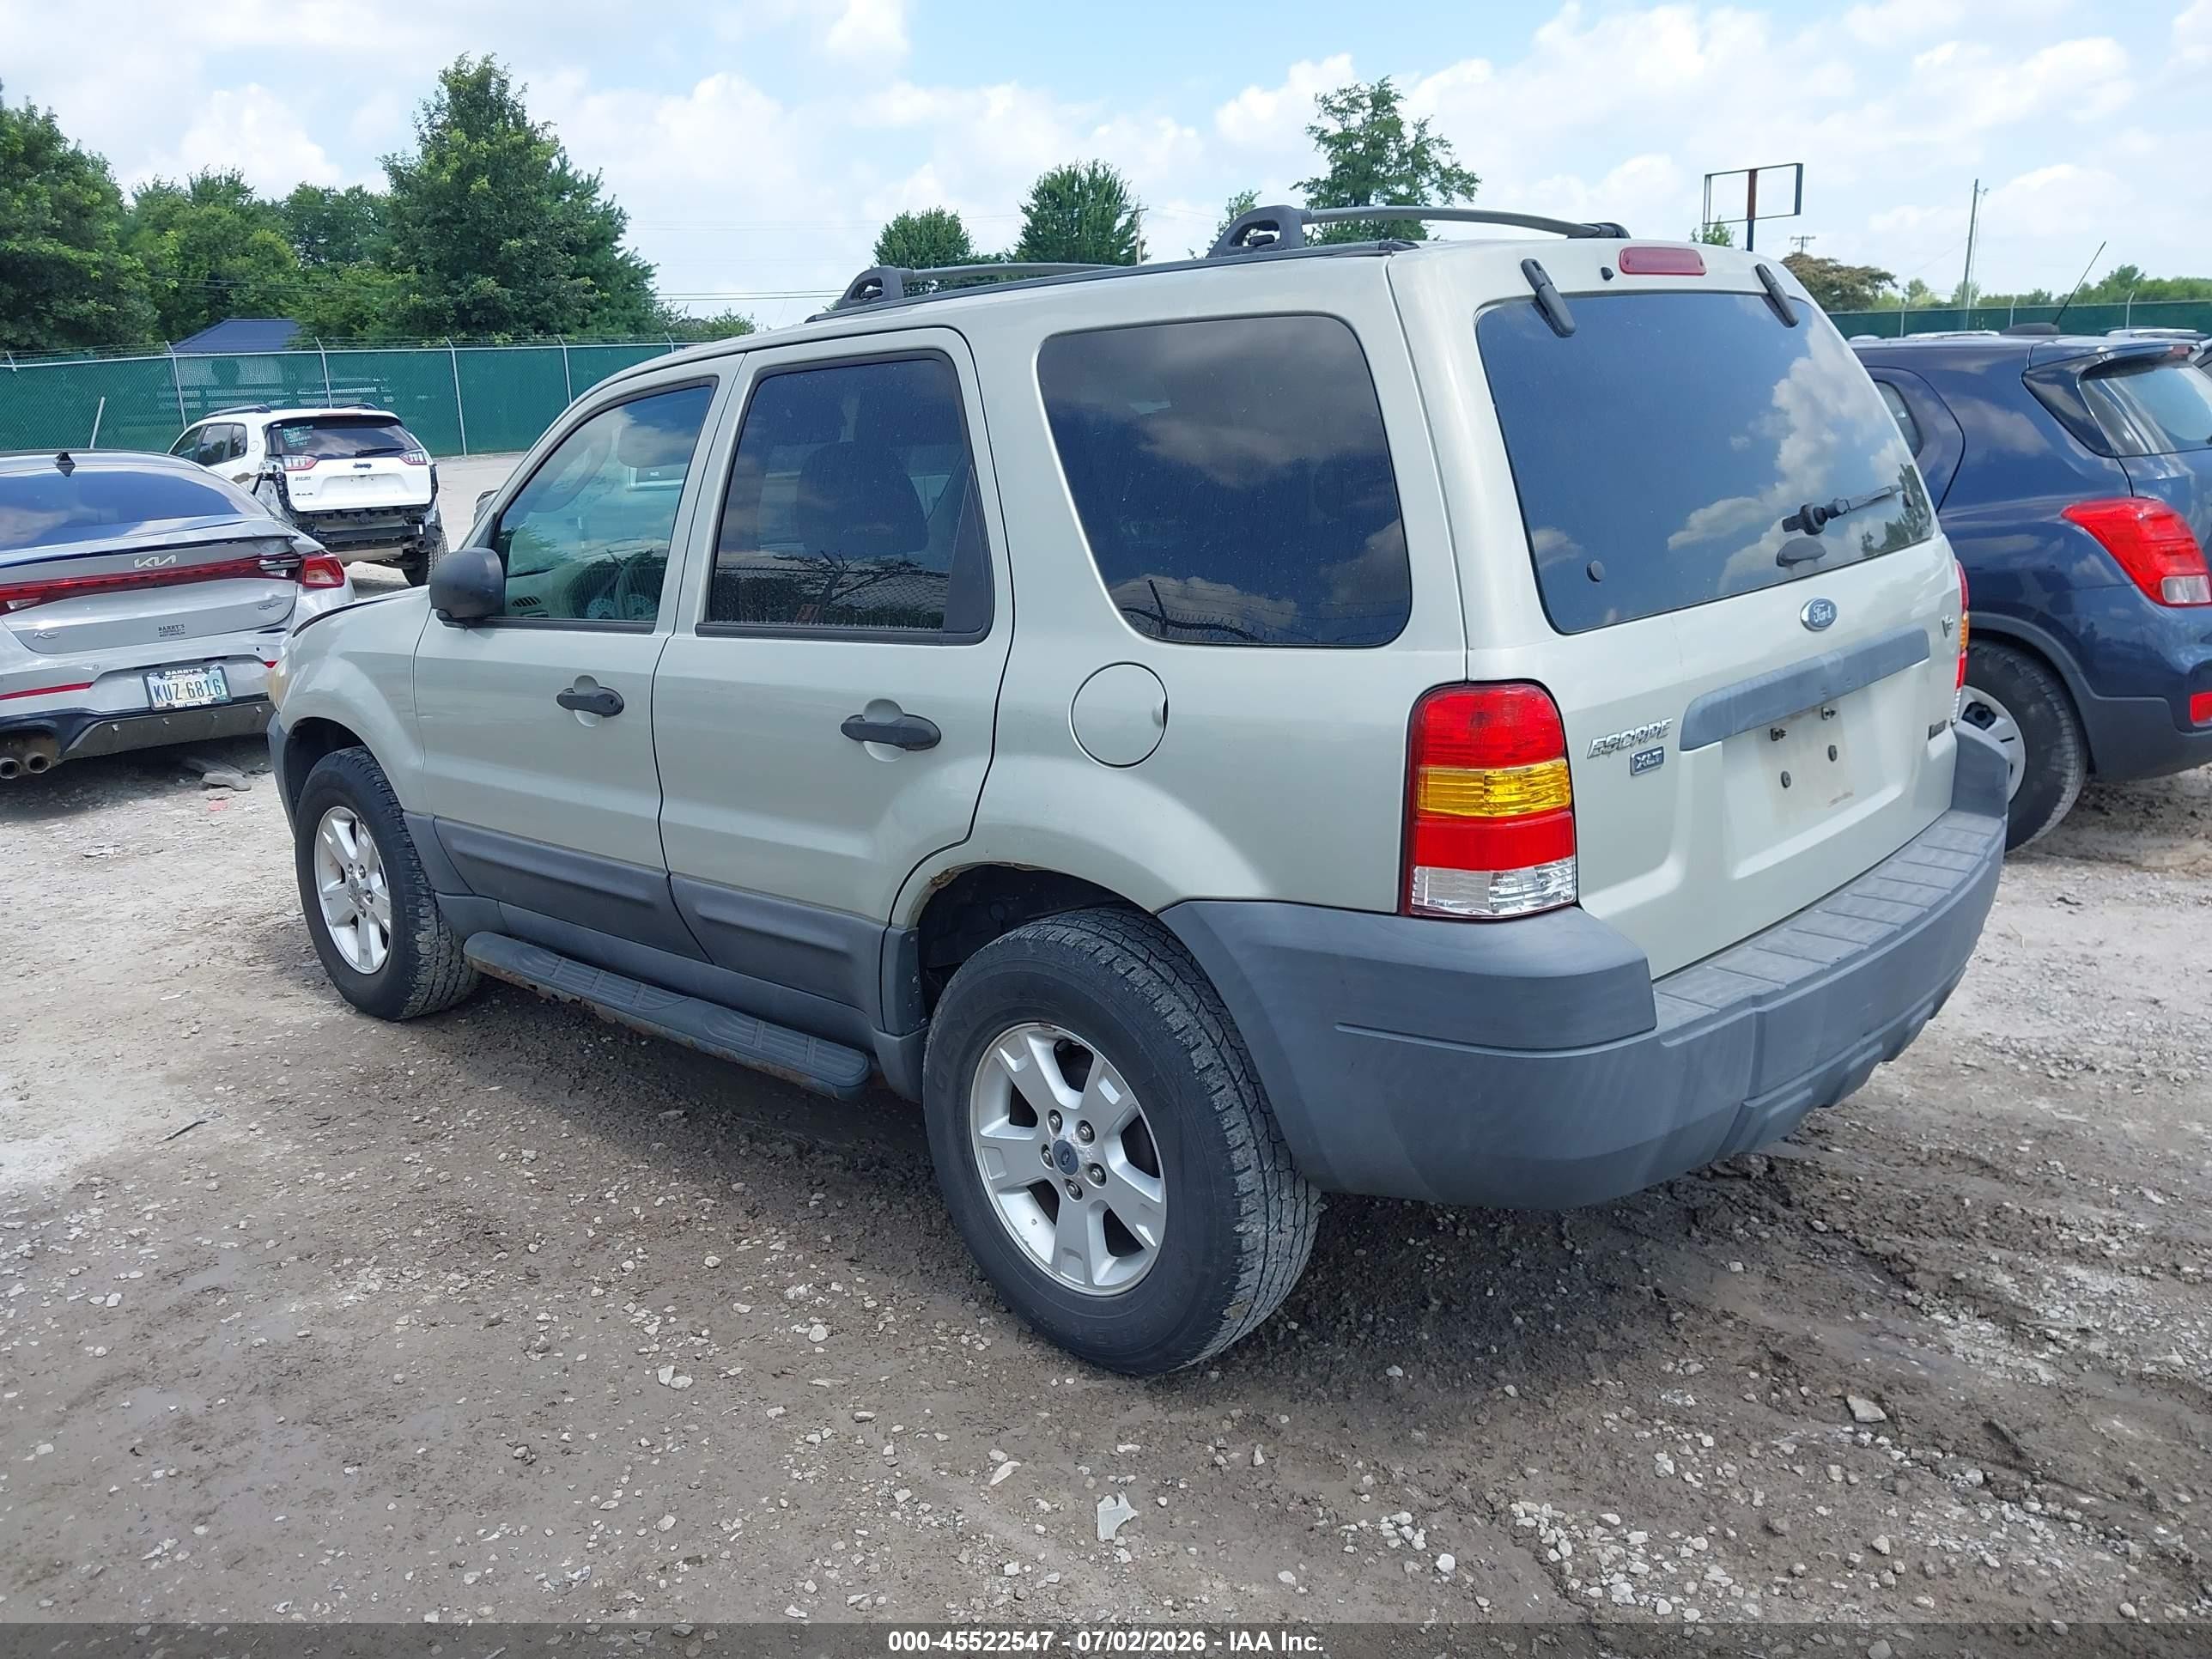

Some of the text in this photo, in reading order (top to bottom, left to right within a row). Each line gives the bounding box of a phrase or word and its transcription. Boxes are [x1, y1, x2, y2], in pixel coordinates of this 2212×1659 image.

[1813, 604, 1832, 623] Ford
[153, 683, 183, 702] KUZ
[185, 678, 222, 698] 6816
[1587, 718, 1674, 760] ESCAPE
[1636, 750, 1662, 769] XLT
